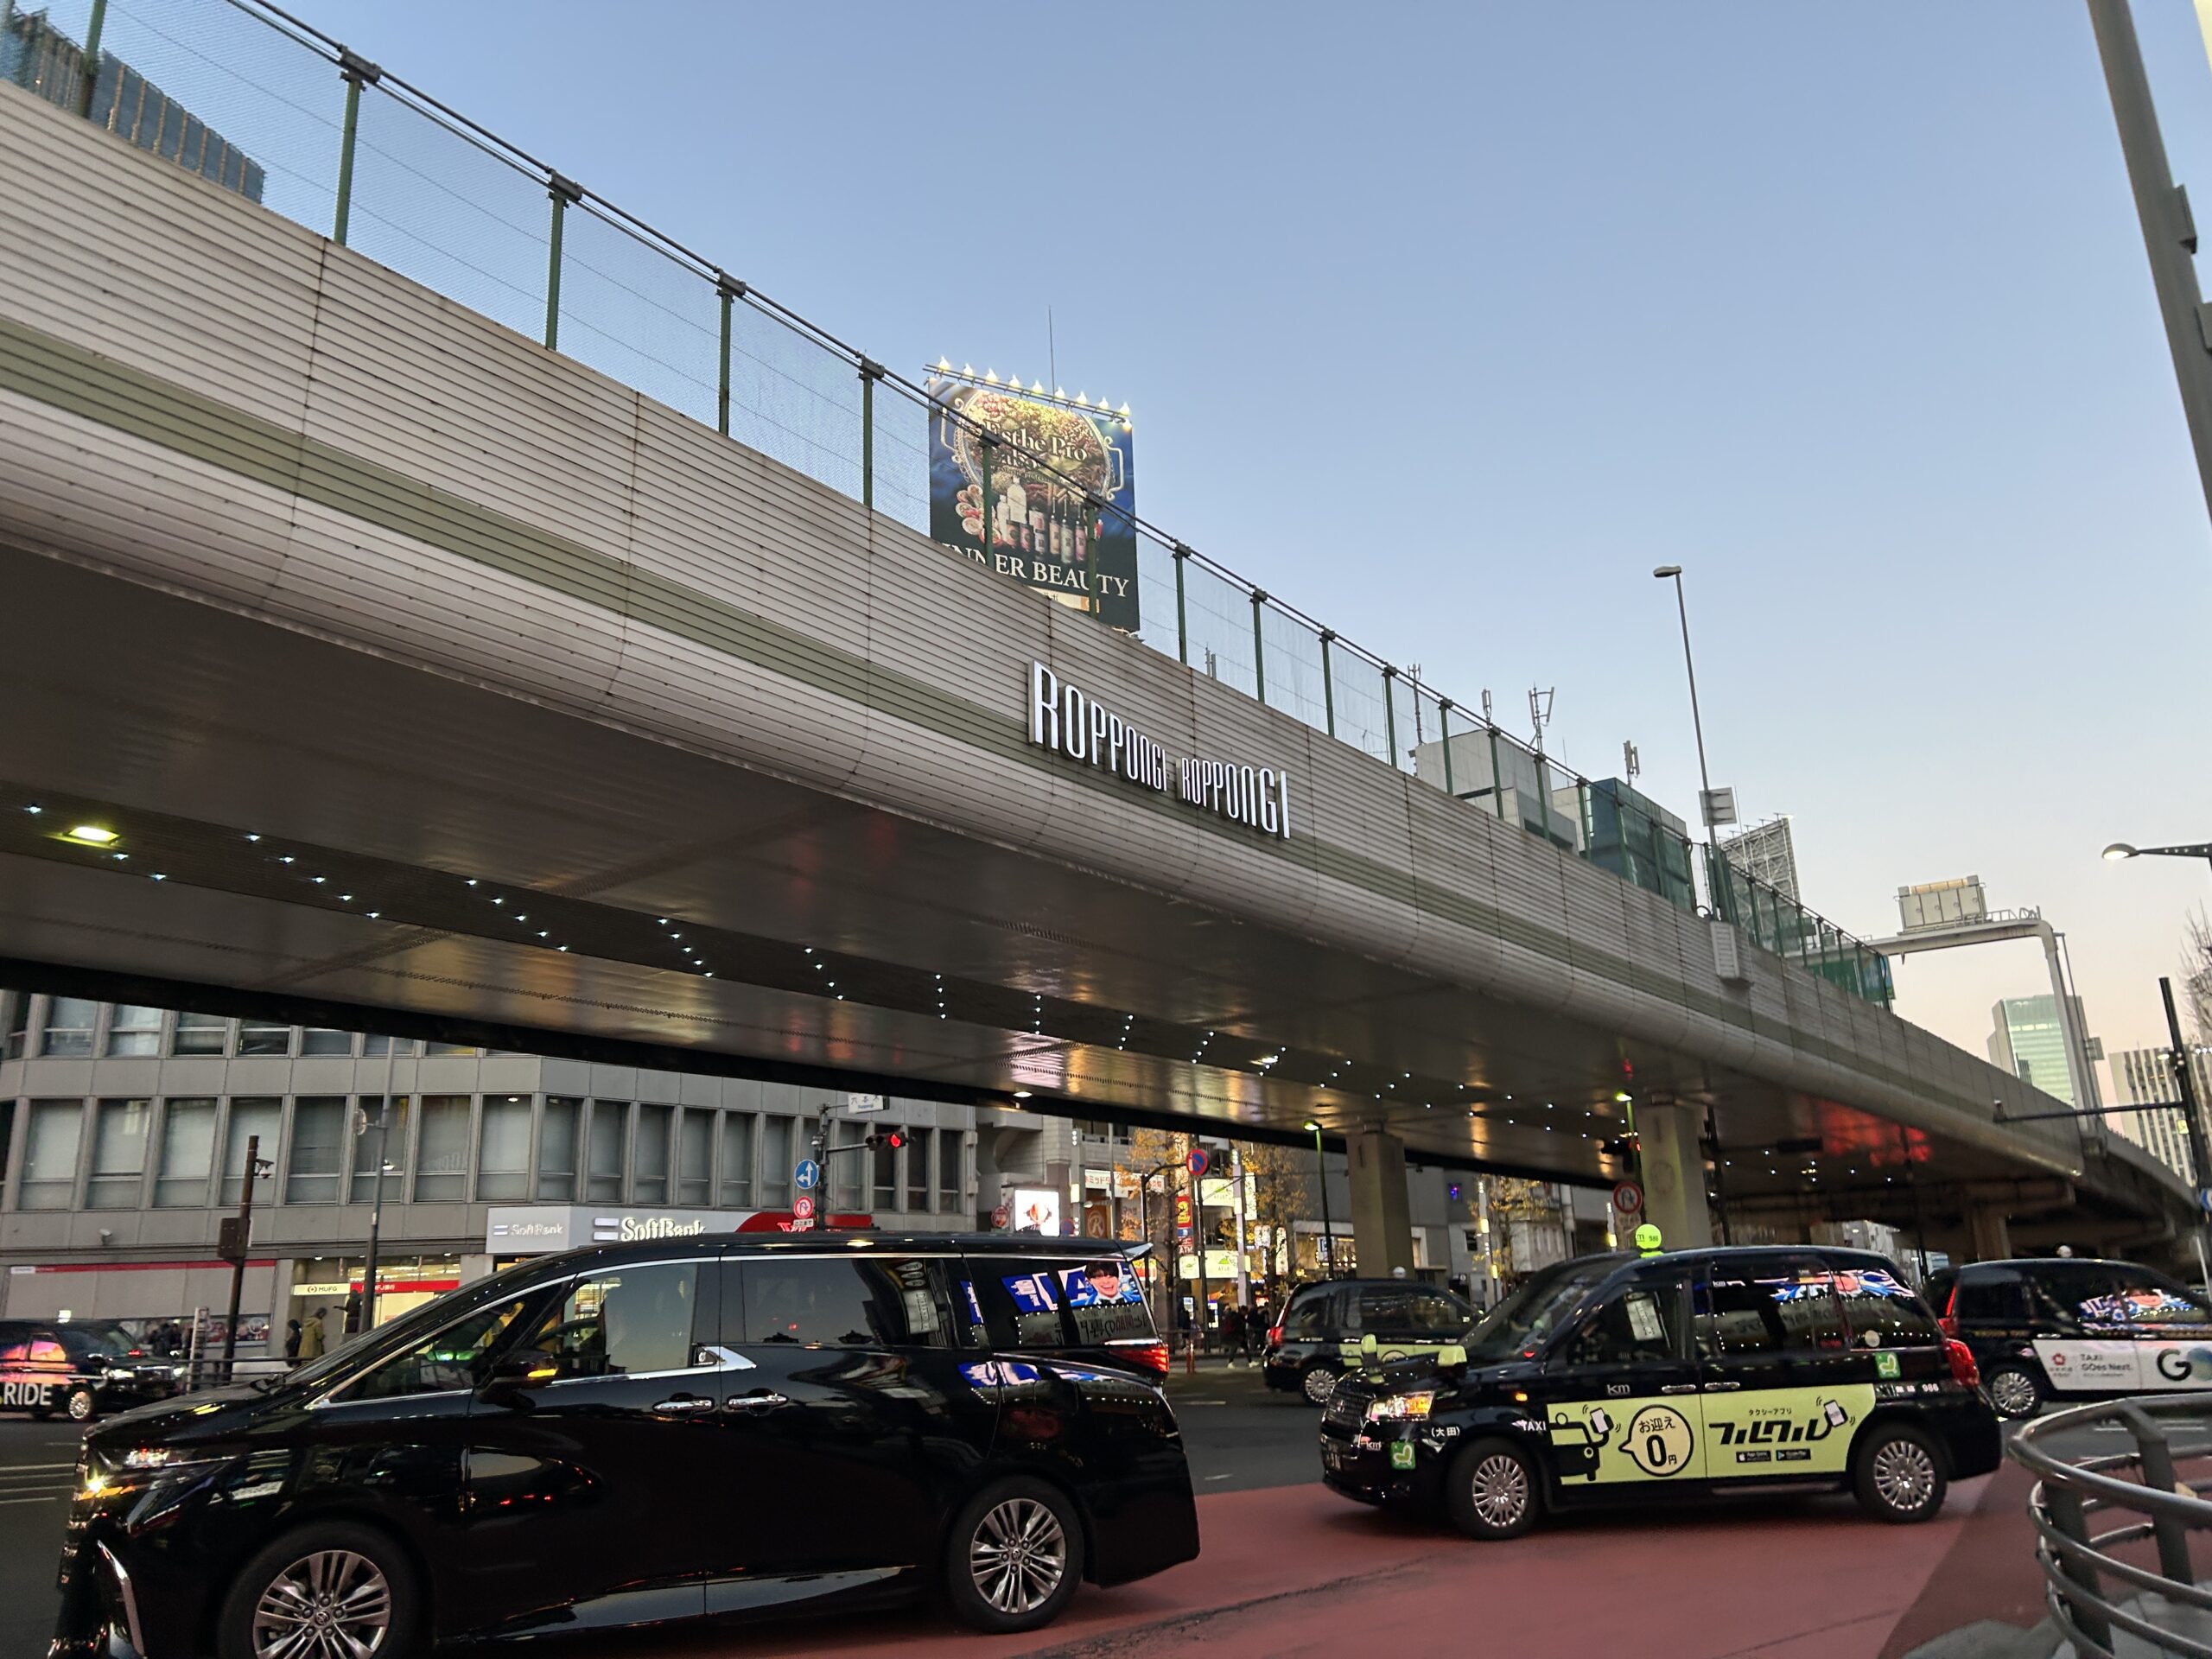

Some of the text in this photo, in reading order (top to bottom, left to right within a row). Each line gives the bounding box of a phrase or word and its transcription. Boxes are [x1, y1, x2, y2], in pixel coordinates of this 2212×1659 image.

[1051, 435, 1088, 461] Pro
[1033, 659, 1290, 840] ROPPONGI ROPPONGI
[511, 1223, 563, 1236] SoftBank
[620, 1217, 705, 1242] SoftBank
[1607, 1383, 1631, 1396] km
[1748, 1408, 1792, 1416] タクシーアプリ
[1522, 1420, 1547, 1432] TAXI
[1638, 1416, 1676, 1433] お迎え
[1431, 1426, 1461, 1438] (大田)
[1365, 1441, 1382, 1452] km
